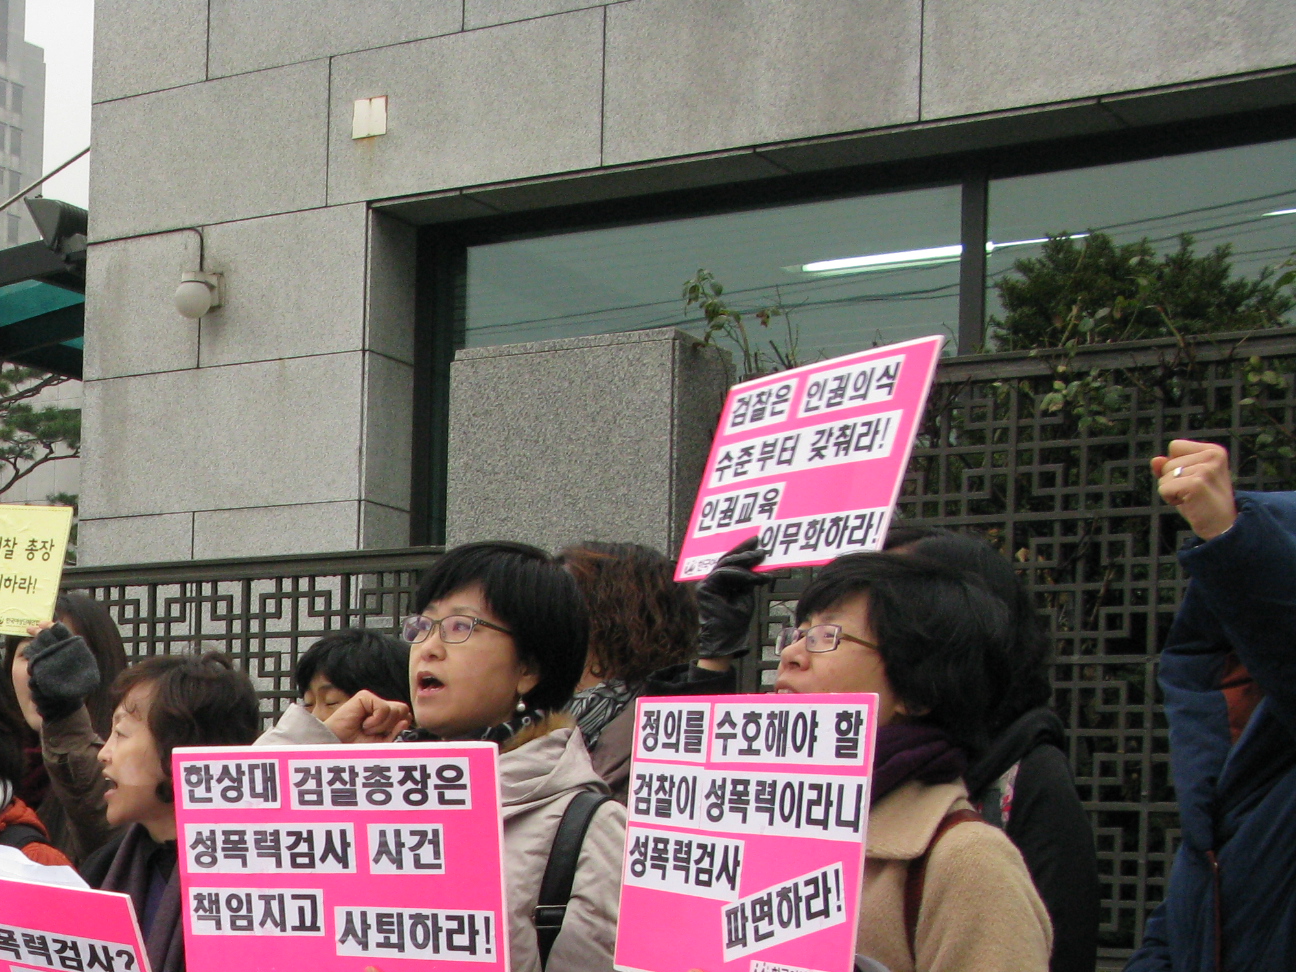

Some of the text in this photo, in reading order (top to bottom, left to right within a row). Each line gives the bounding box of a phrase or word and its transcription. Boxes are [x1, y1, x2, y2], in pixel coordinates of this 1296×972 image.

[730, 361, 901, 428] 검찰은 인권의식
[715, 417, 891, 483] 수준부터 갖춰라!
[698, 487, 780, 532] 인권교육
[25, 538, 55, 562] 총장
[641, 709, 863, 759] 정의를 수호해야 할
[183, 762, 468, 807] 한상대 검찰총장은
[633, 773, 863, 834] 검찰이 성폭력이라니
[189, 828, 443, 870] 성폭력검사 사건
[629, 835, 843, 949] 성폭력검사 파면하라!
[192, 892, 492, 956] 책임지고 사퇴하라!
